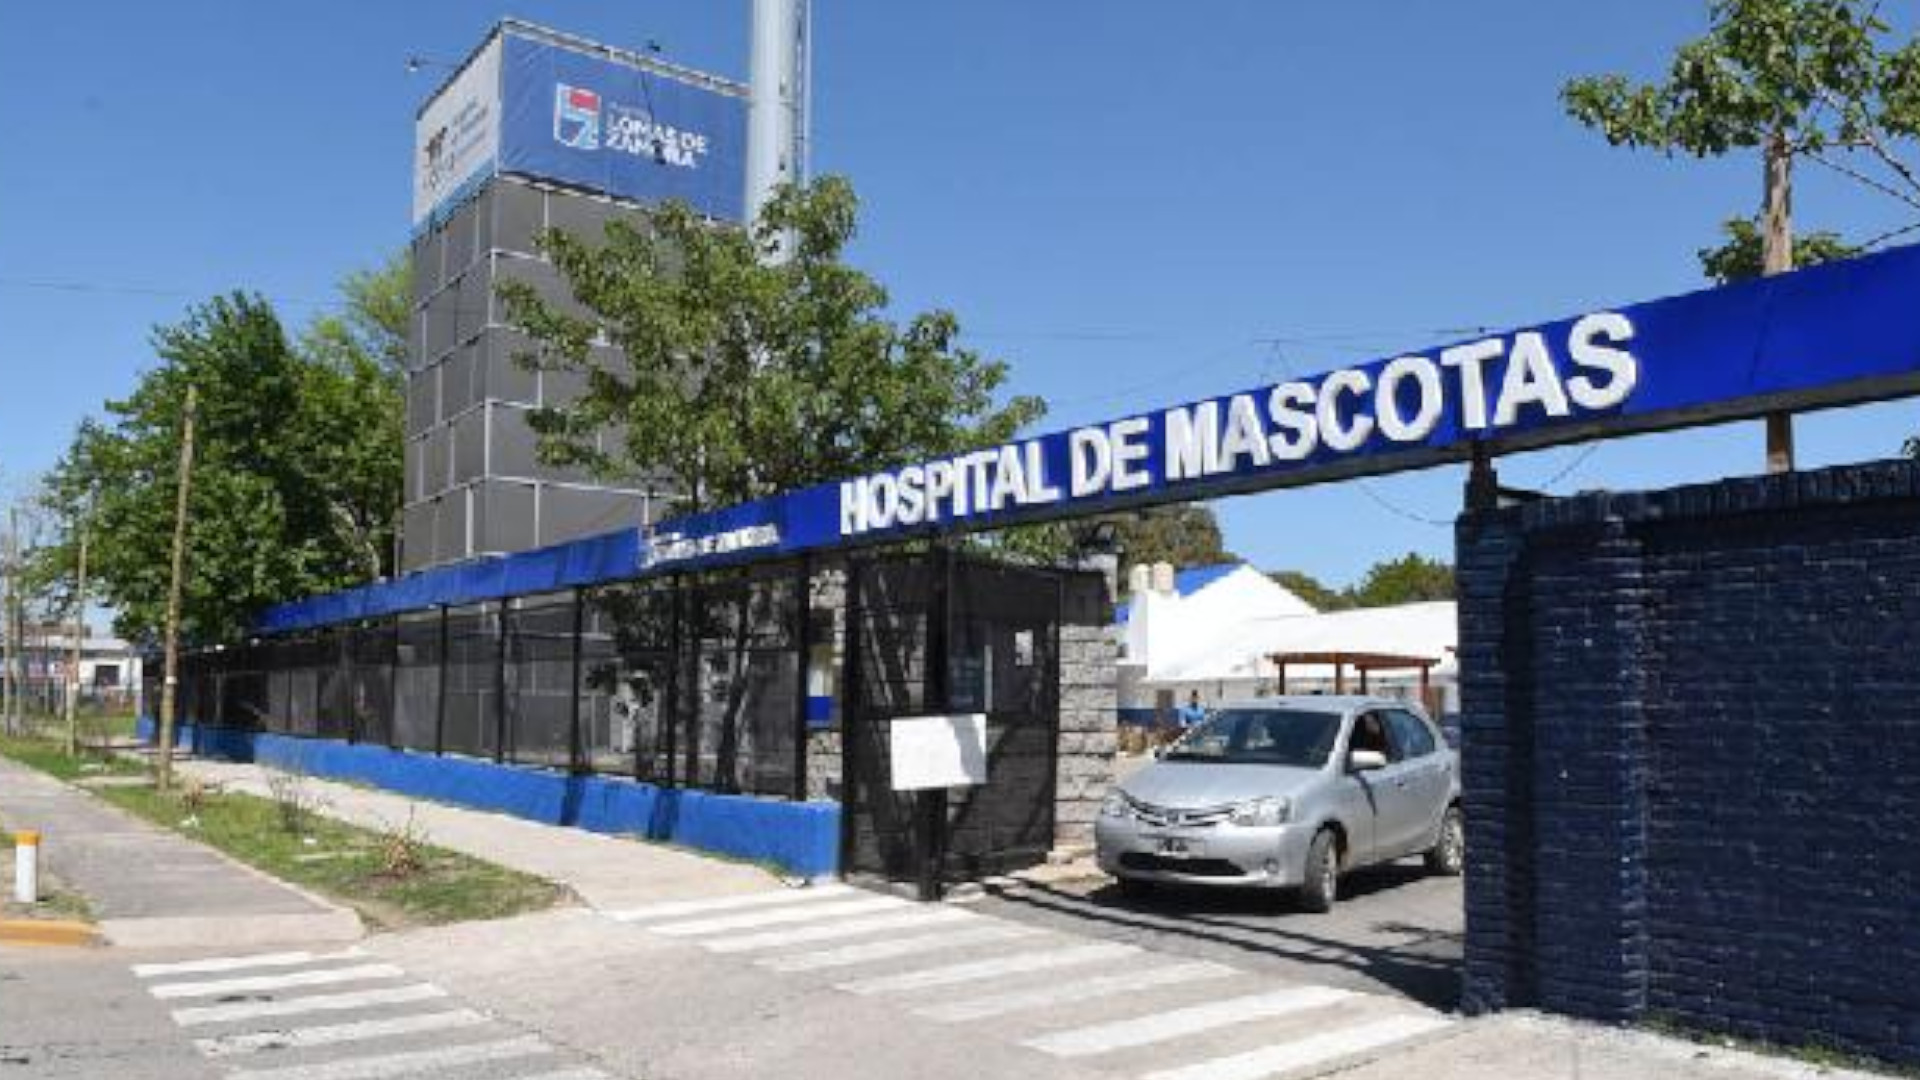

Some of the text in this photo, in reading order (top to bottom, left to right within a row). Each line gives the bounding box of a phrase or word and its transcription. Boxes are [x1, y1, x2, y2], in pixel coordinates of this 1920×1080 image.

[681, 132, 707, 154] DE
[840, 312, 1637, 534] HOSPITAL DE MASCOTAS
